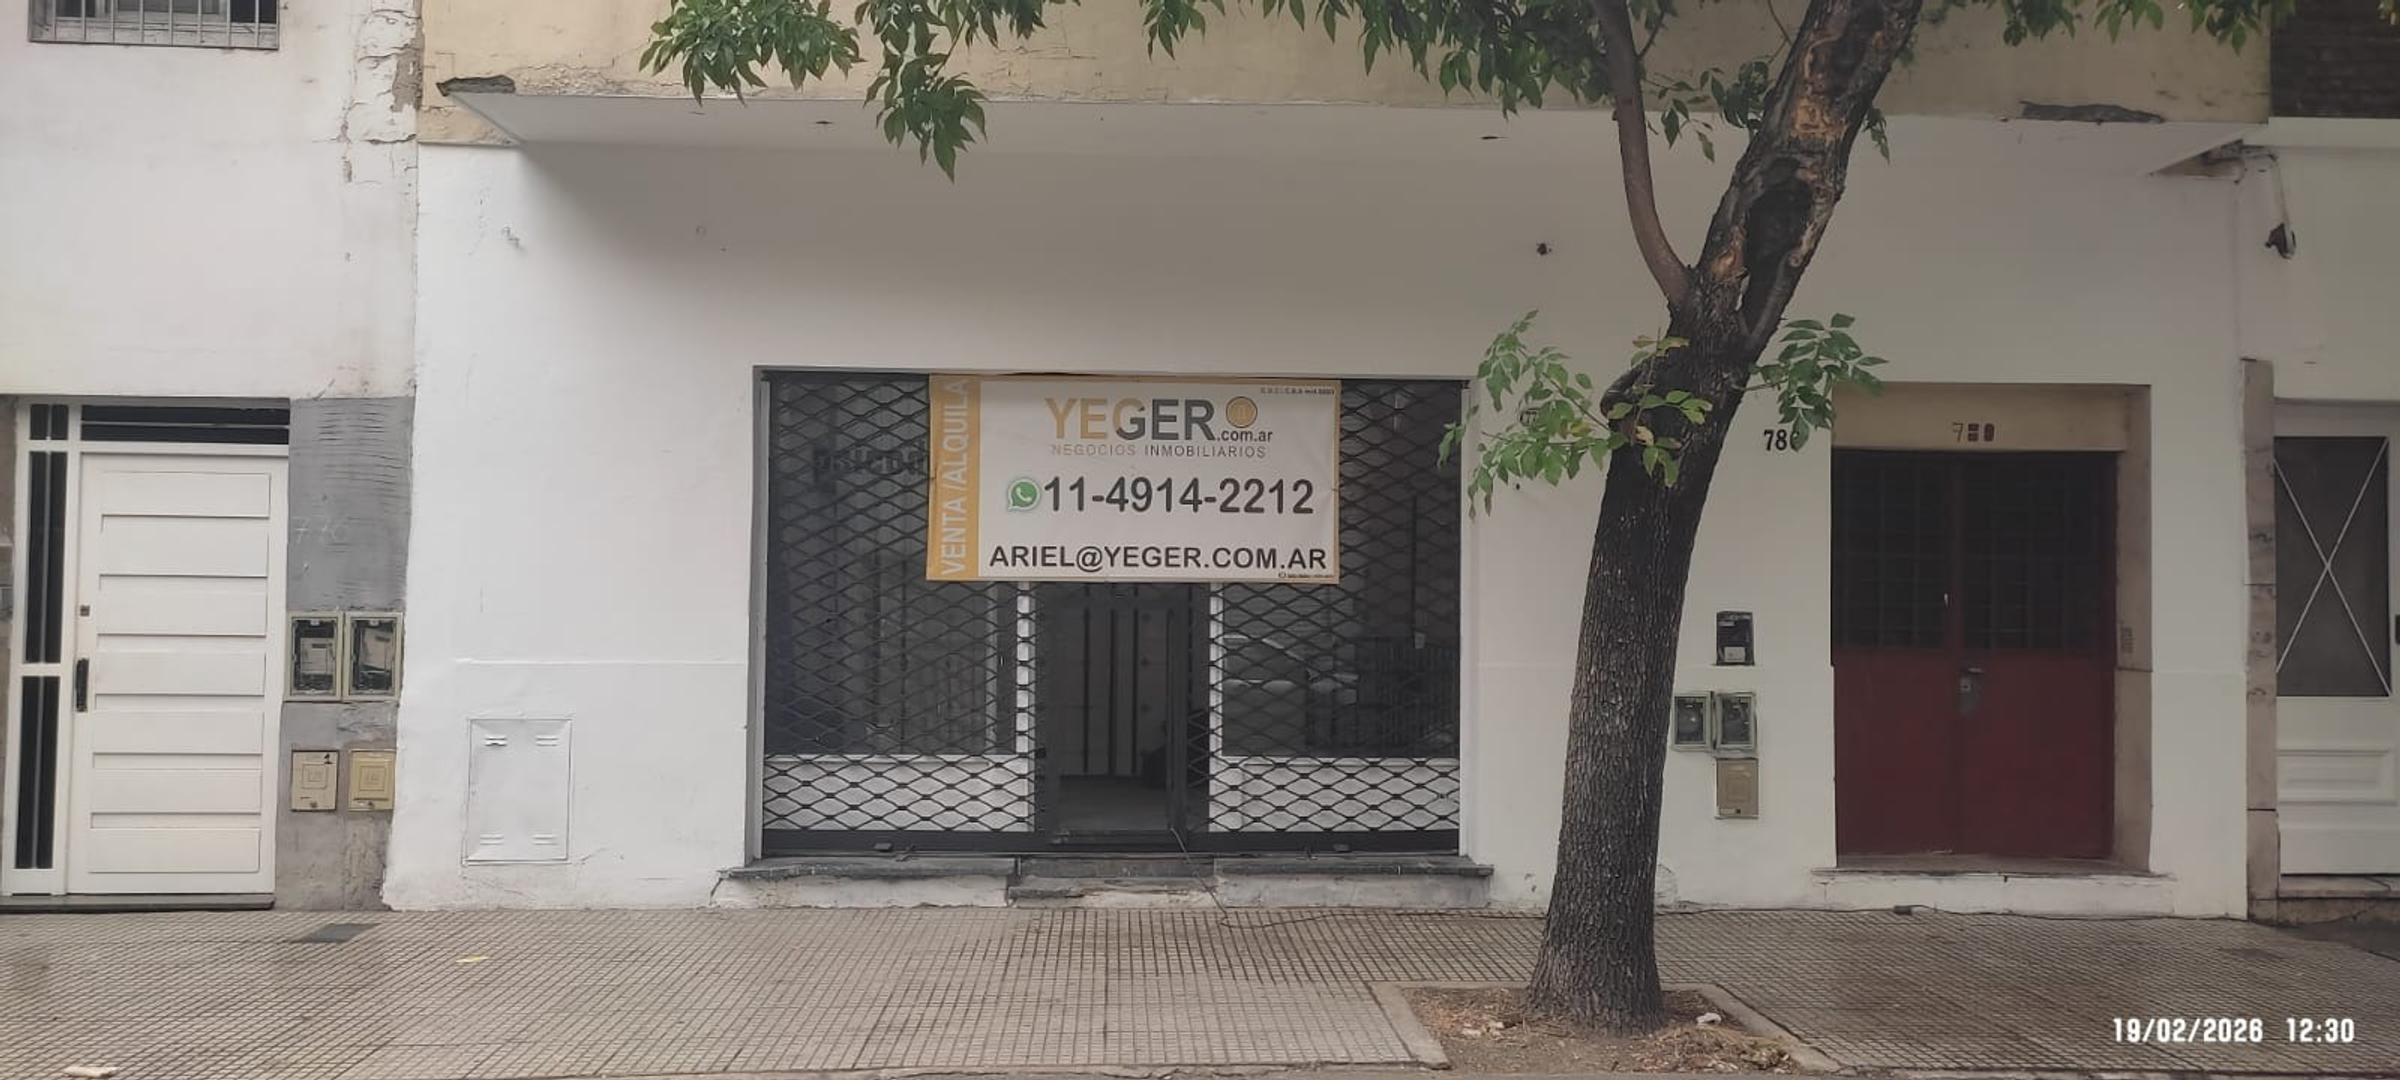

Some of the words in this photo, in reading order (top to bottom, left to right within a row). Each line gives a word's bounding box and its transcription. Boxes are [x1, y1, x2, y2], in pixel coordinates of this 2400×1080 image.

[1051, 444, 1136, 456] NEGOCIOS
[1145, 445, 1266, 459] INMOBILIARIOS
[1044, 476, 1314, 514] 11-4914-2212
[941, 496, 968, 576] VENTA
[989, 545, 1327, 572] ARIEL@YEGER.COM.AR
